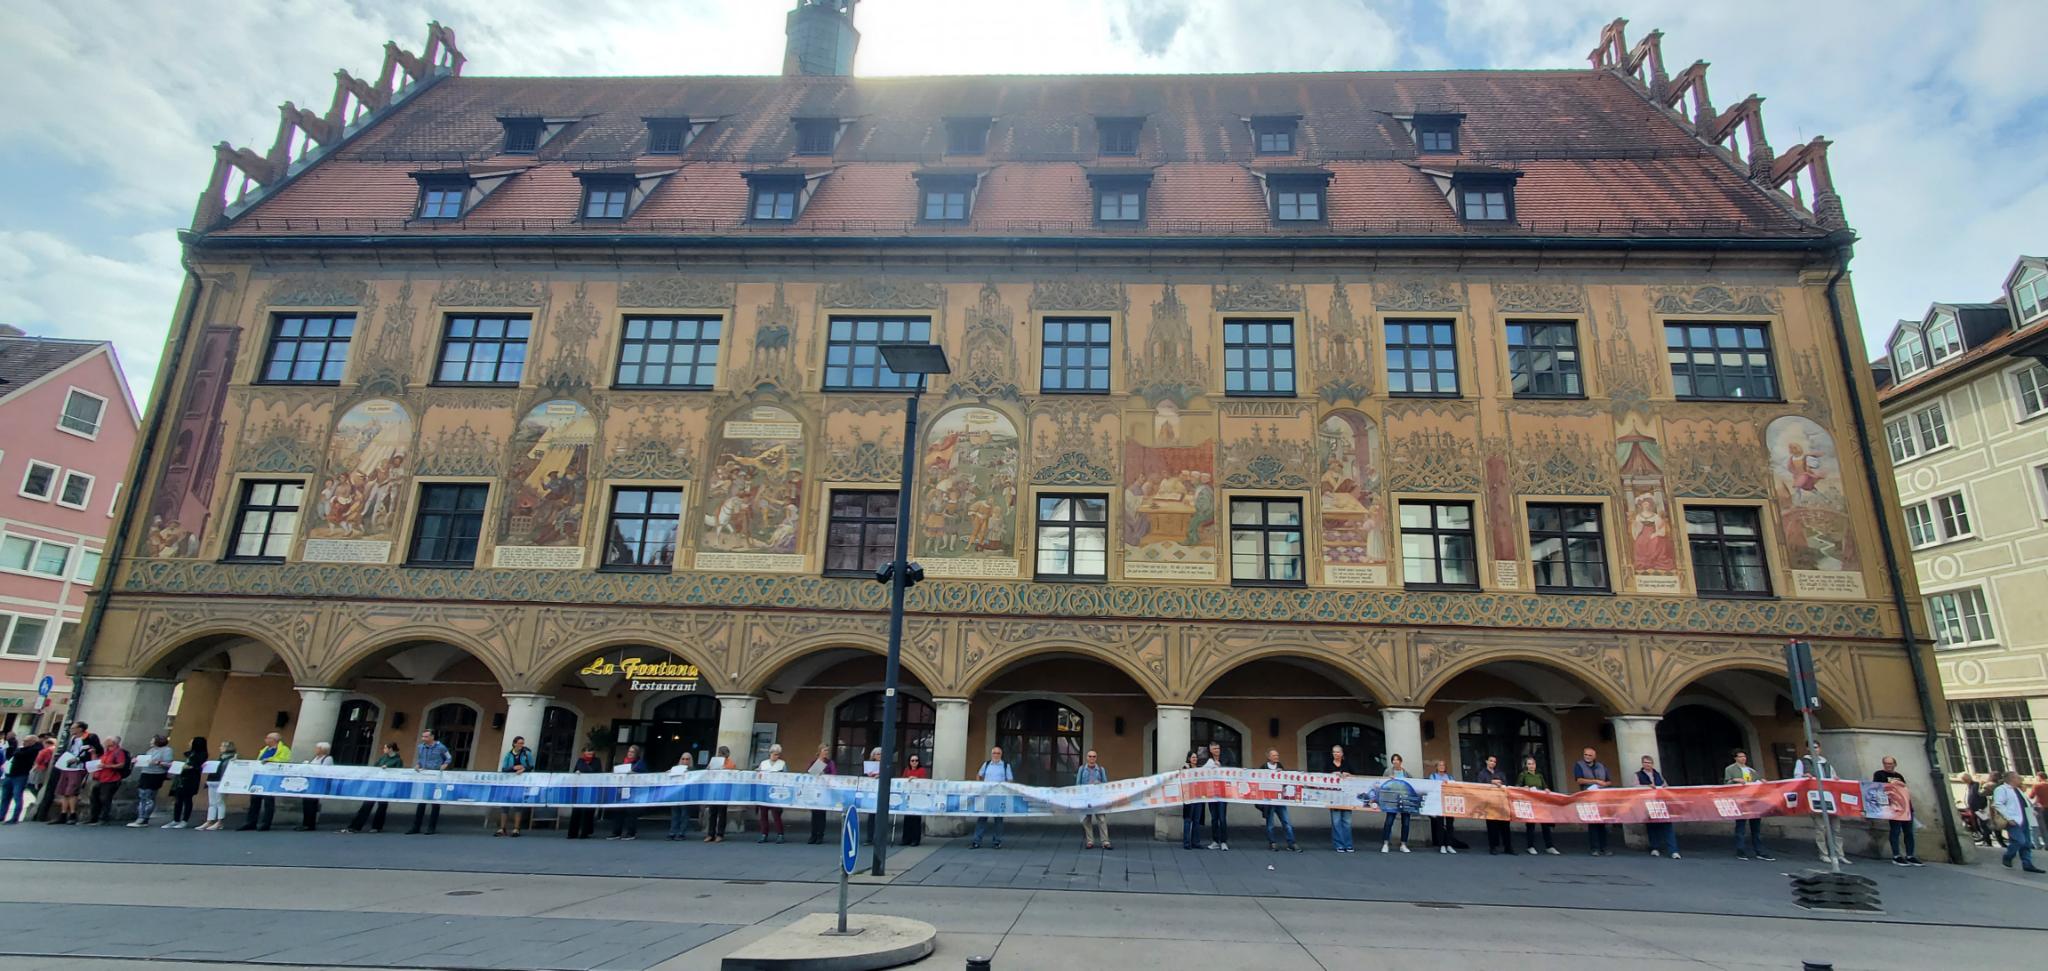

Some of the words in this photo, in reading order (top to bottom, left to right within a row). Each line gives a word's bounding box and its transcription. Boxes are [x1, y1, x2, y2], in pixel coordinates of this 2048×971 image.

[580, 657, 614, 675] La
[620, 658, 699, 680] Fontana
[630, 680, 697, 692] Restaurant
